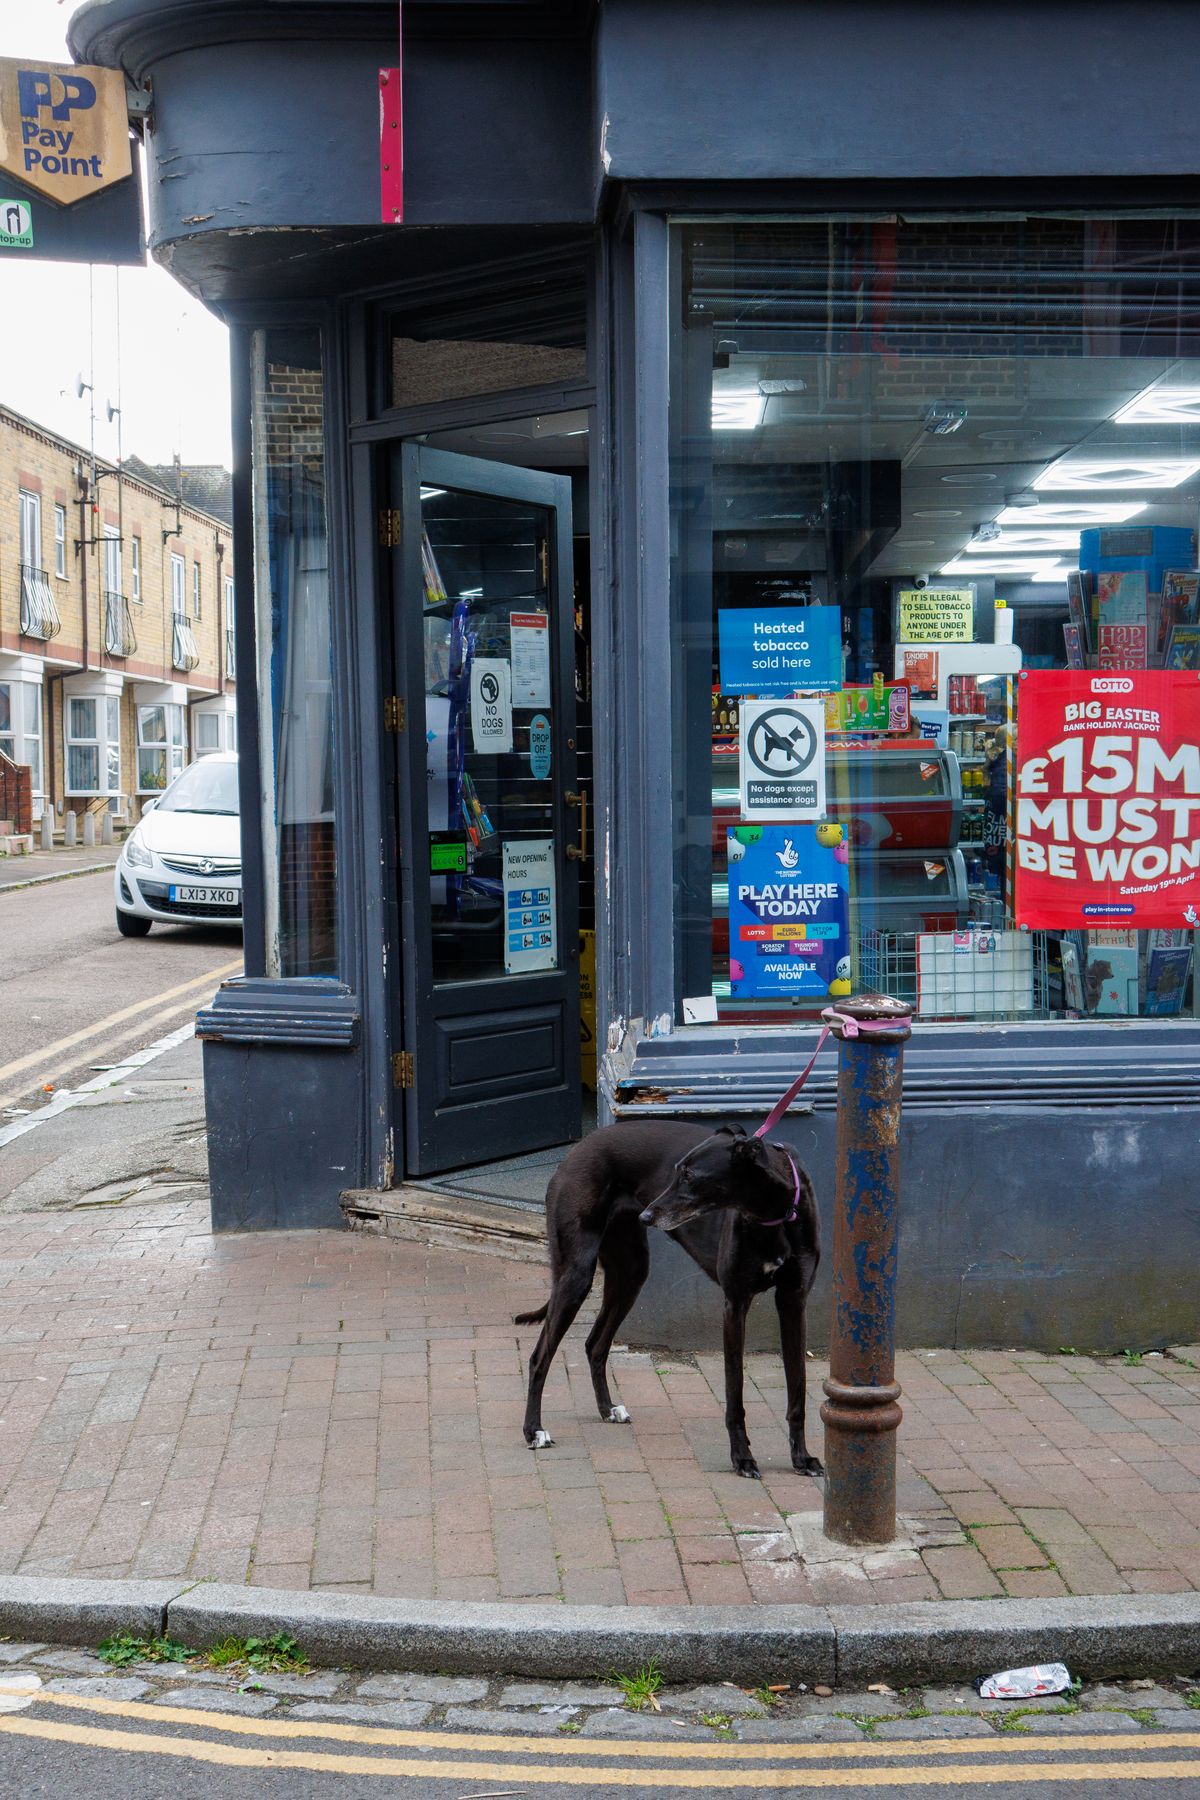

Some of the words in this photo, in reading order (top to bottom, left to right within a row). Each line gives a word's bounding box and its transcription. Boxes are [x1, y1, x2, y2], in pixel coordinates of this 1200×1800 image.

[22, 121, 73, 154] Pay
[24, 148, 103, 177] Point
[753, 621, 805, 634] Heated
[753, 639, 809, 652] tobacco
[752, 657, 779, 669] sold
[782, 656, 811, 668] here
[1094, 681, 1131, 690] LOTTO
[485, 705, 497, 715] NO
[1065, 701, 1102, 722] BIG
[1106, 707, 1160, 723] EASTER
[482, 718, 503, 728] DOGS
[1063, 723, 1085, 732] BANK
[1086, 721, 1123, 730] HOLIDAY
[1123, 722, 1160, 732] JACKPOT
[532, 734, 549, 742] DROP
[535, 745, 546, 754] OFF
[1017, 735, 1200, 794] £15M
[765, 785, 785, 794] dogs
[787, 785, 814, 793] except
[795, 796, 815, 804] dogs
[1017, 798, 1200, 844] MUST
[508, 856, 521, 864] NEW
[522, 853, 547, 863] OPENING
[1017, 838, 1077, 880] BE
[1084, 839, 1200, 881] WON
[507, 869, 528, 879] HOURS
[1120, 883, 1158, 895] Saturday
[1160, 879, 1176, 890] 19th
[1176, 872, 1195, 886] April
[180, 888, 207, 900] LX13
[738, 884, 786, 900] PLAY
[789, 883, 838, 899] HERE
[756, 900, 821, 916] TODAY
[1084, 906, 1097, 914] play
[764, 963, 816, 972] AVAILABLE
[779, 972, 802, 980] NOW
